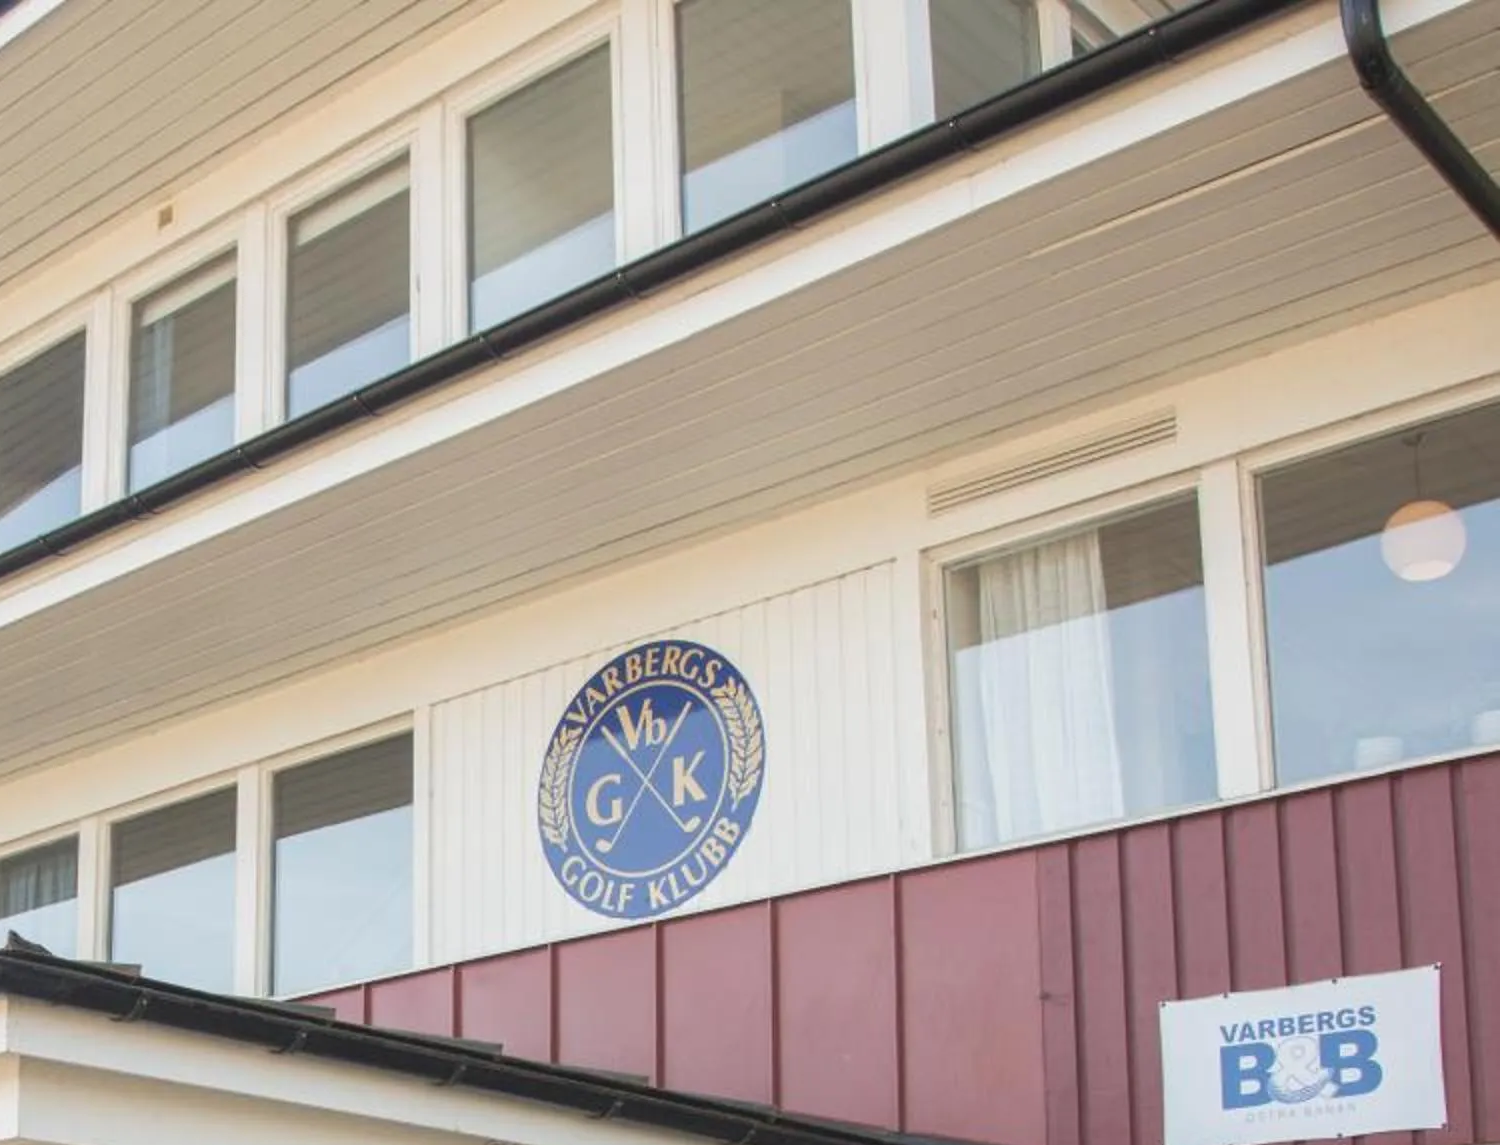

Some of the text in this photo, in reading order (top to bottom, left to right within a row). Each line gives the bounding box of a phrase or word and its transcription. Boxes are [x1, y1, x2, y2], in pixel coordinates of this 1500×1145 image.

[566, 645, 721, 732] VARBERGS
[586, 749, 707, 826] G K
[560, 816, 741, 912] GOLF KLUBB
[1219, 1005, 1377, 1043] VARBERGS
